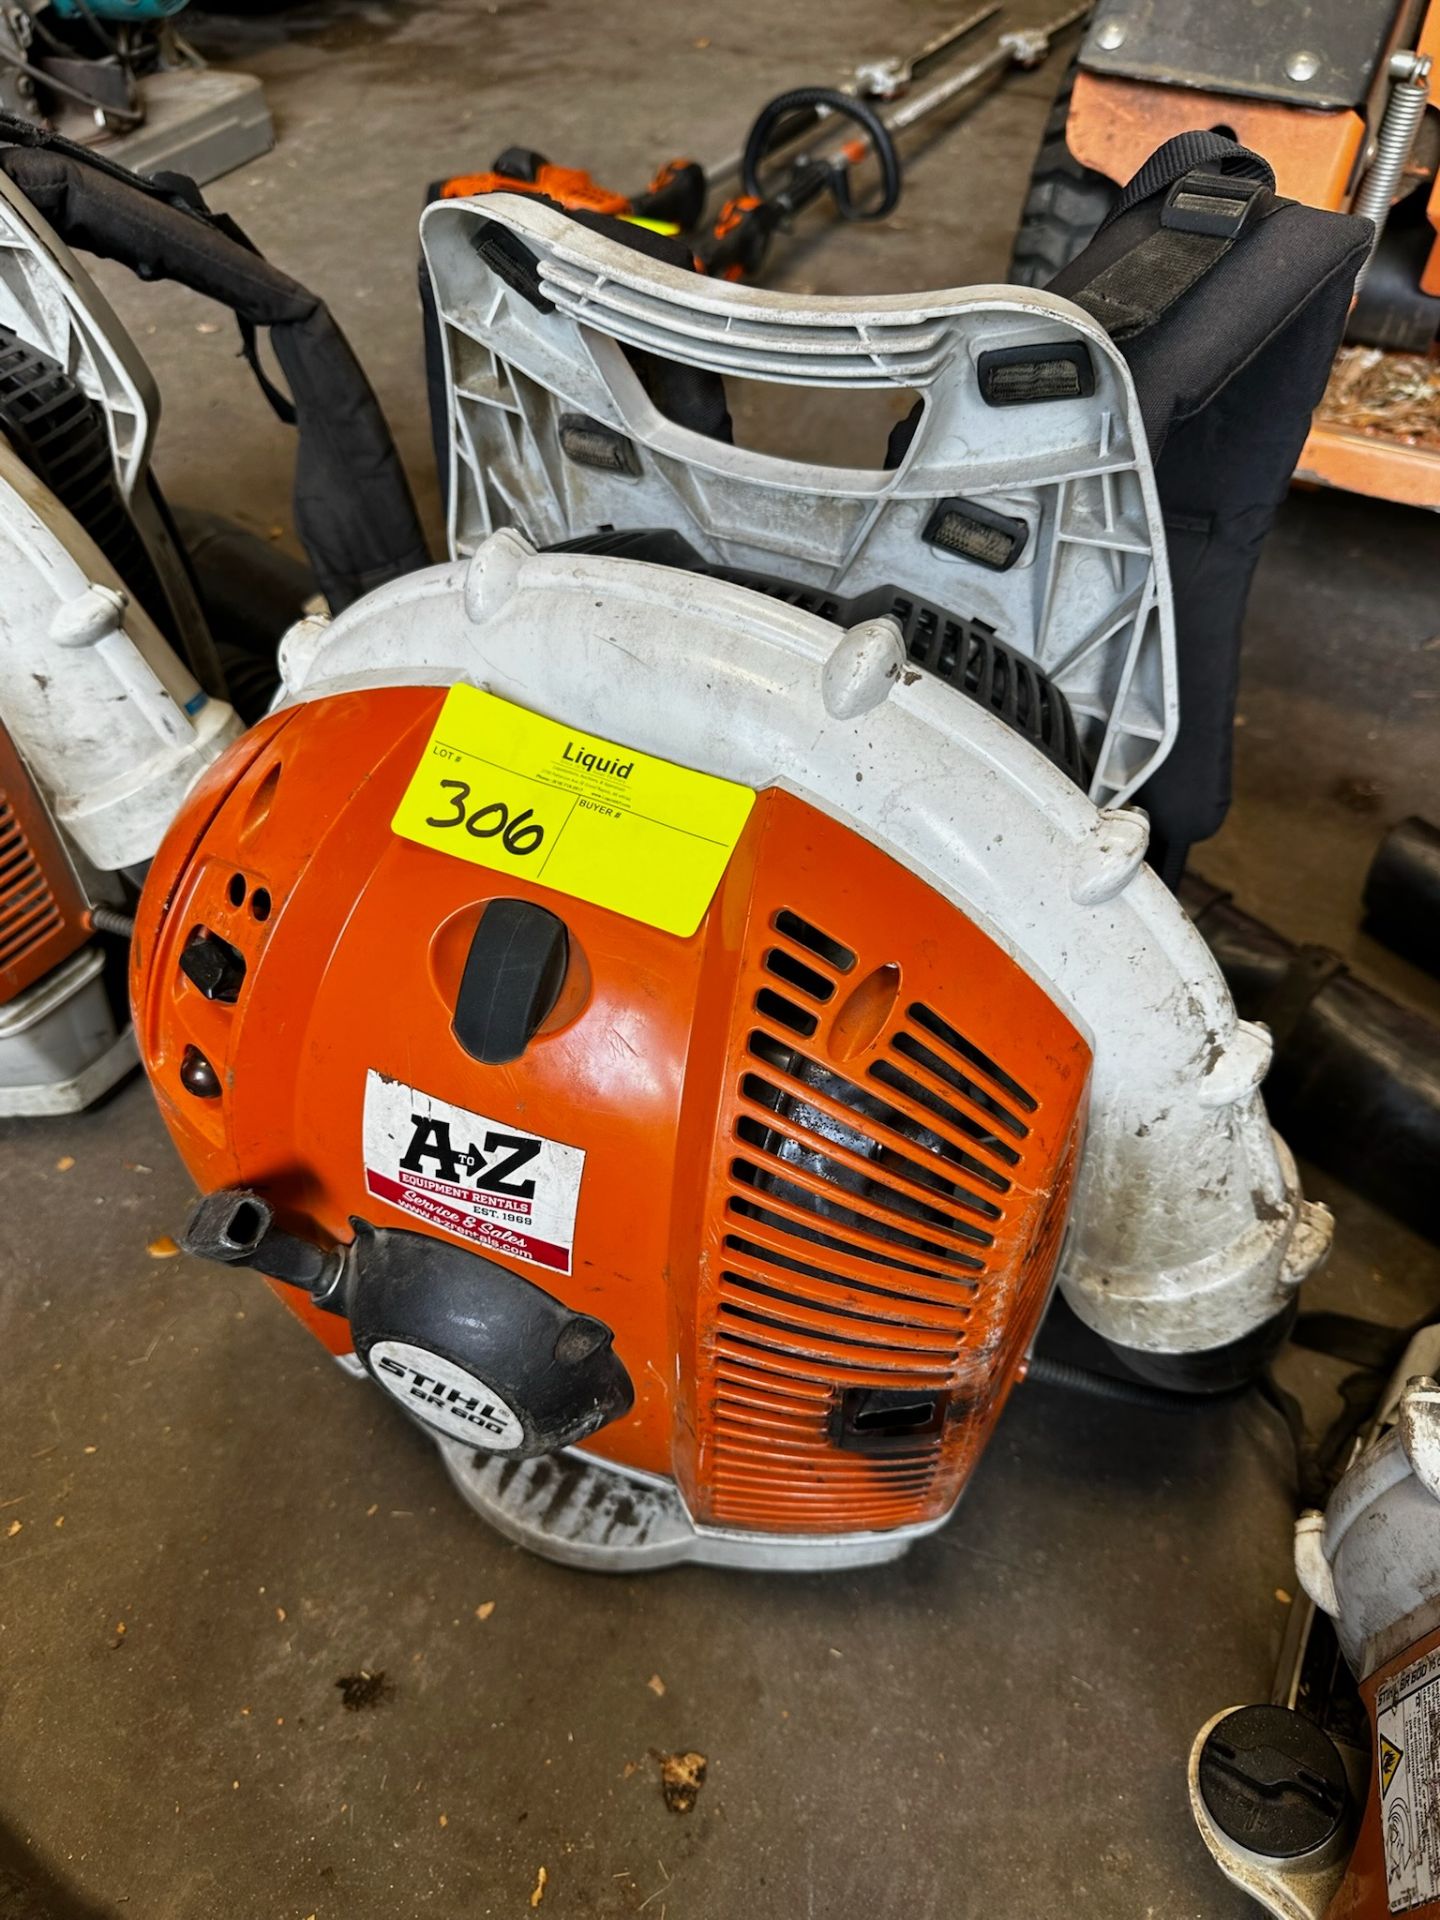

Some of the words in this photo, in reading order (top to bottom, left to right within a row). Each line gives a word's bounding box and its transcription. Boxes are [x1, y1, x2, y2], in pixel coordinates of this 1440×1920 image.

[432, 746, 453, 761] LOT
[562, 741, 635, 780] Liquid
[426, 779, 544, 856] 306
[578, 799, 614, 818] BUYER
[401, 1173, 469, 1199] EQUIPMENT
[472, 1193, 529, 1214] RENTALS
[397, 1199, 533, 1260] www.a-zrentals.com
[402, 1190, 460, 1223] Service
[462, 1216, 477, 1229] &
[478, 1222, 528, 1249] Sales
[473, 1206, 500, 1219] EST.
[502, 1212, 533, 1226] 1969
[378, 1356, 508, 1427] STIHL
[410, 1387, 446, 1409] BR
[450, 1406, 504, 1435] 600
